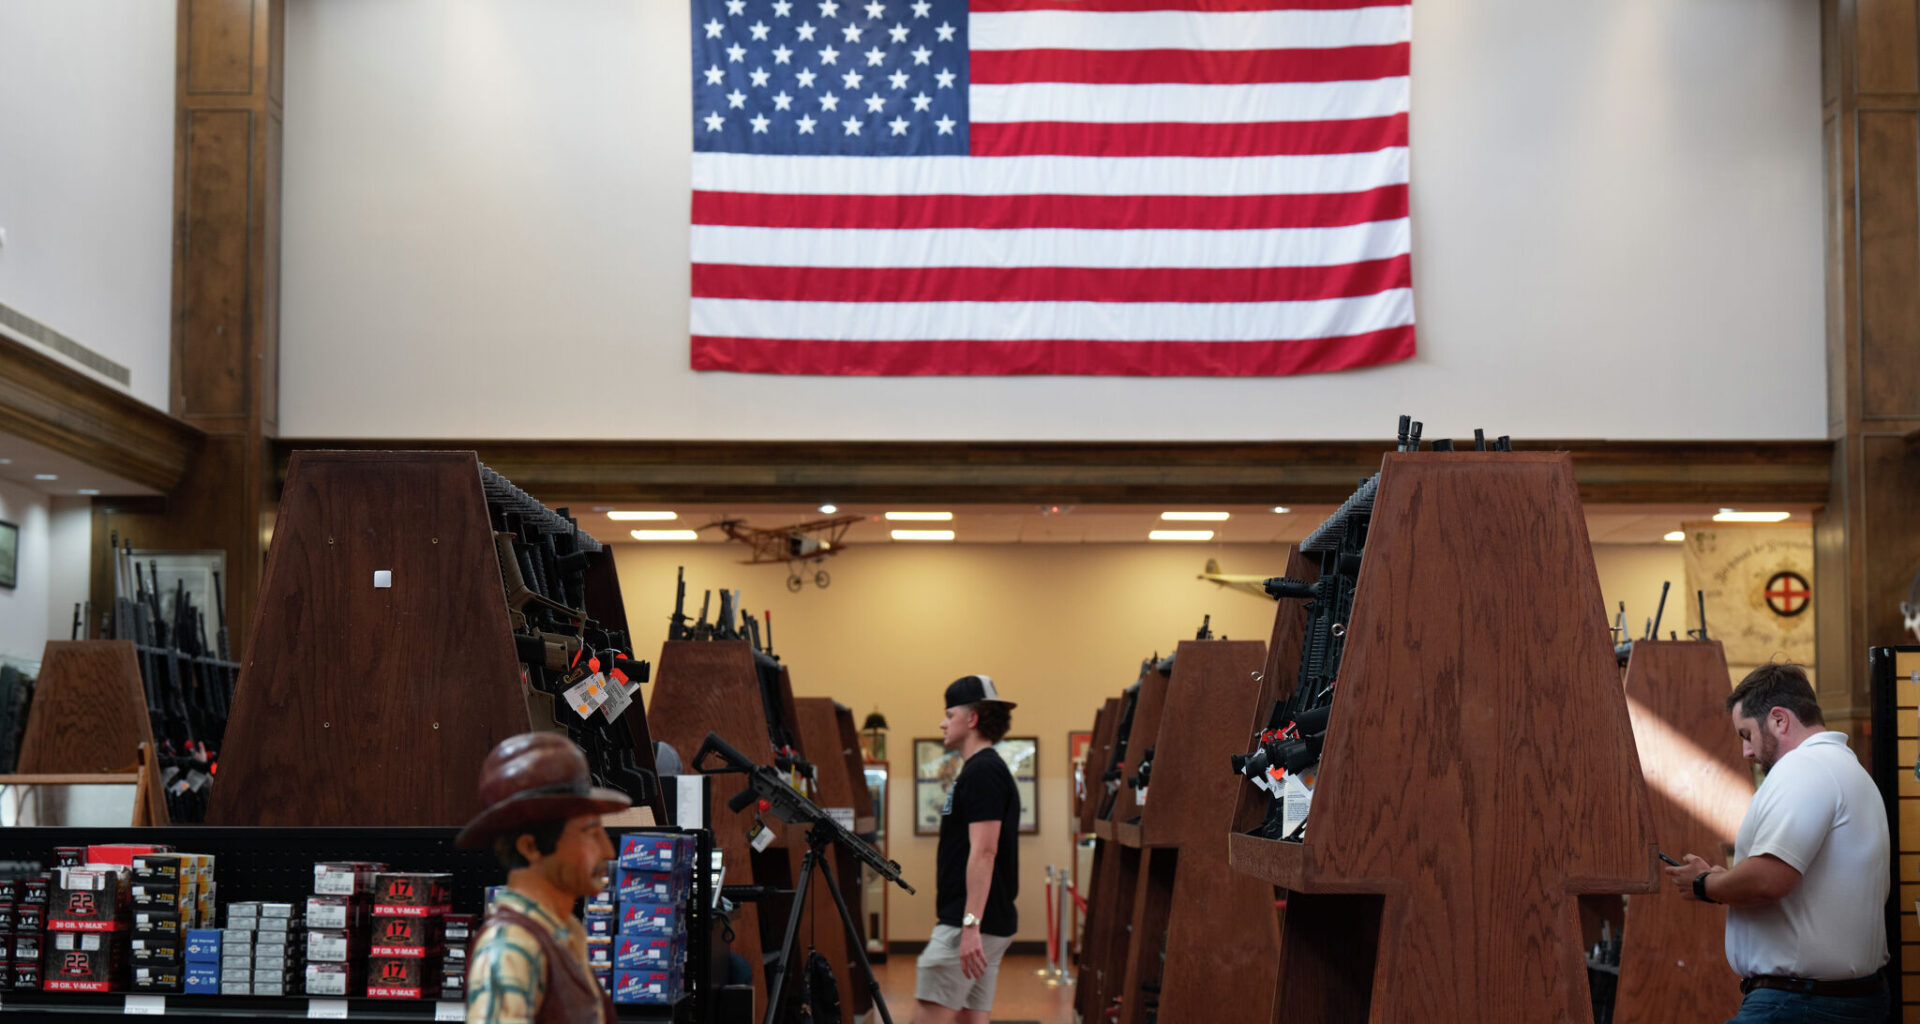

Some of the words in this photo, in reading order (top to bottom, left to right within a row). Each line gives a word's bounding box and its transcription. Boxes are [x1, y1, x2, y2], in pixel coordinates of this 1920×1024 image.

[395, 881, 410, 895] 17
[70, 893, 94, 908] 22
[392, 922, 407, 936] 17
[65, 953, 89, 968] 22
[388, 963, 403, 976] 17
